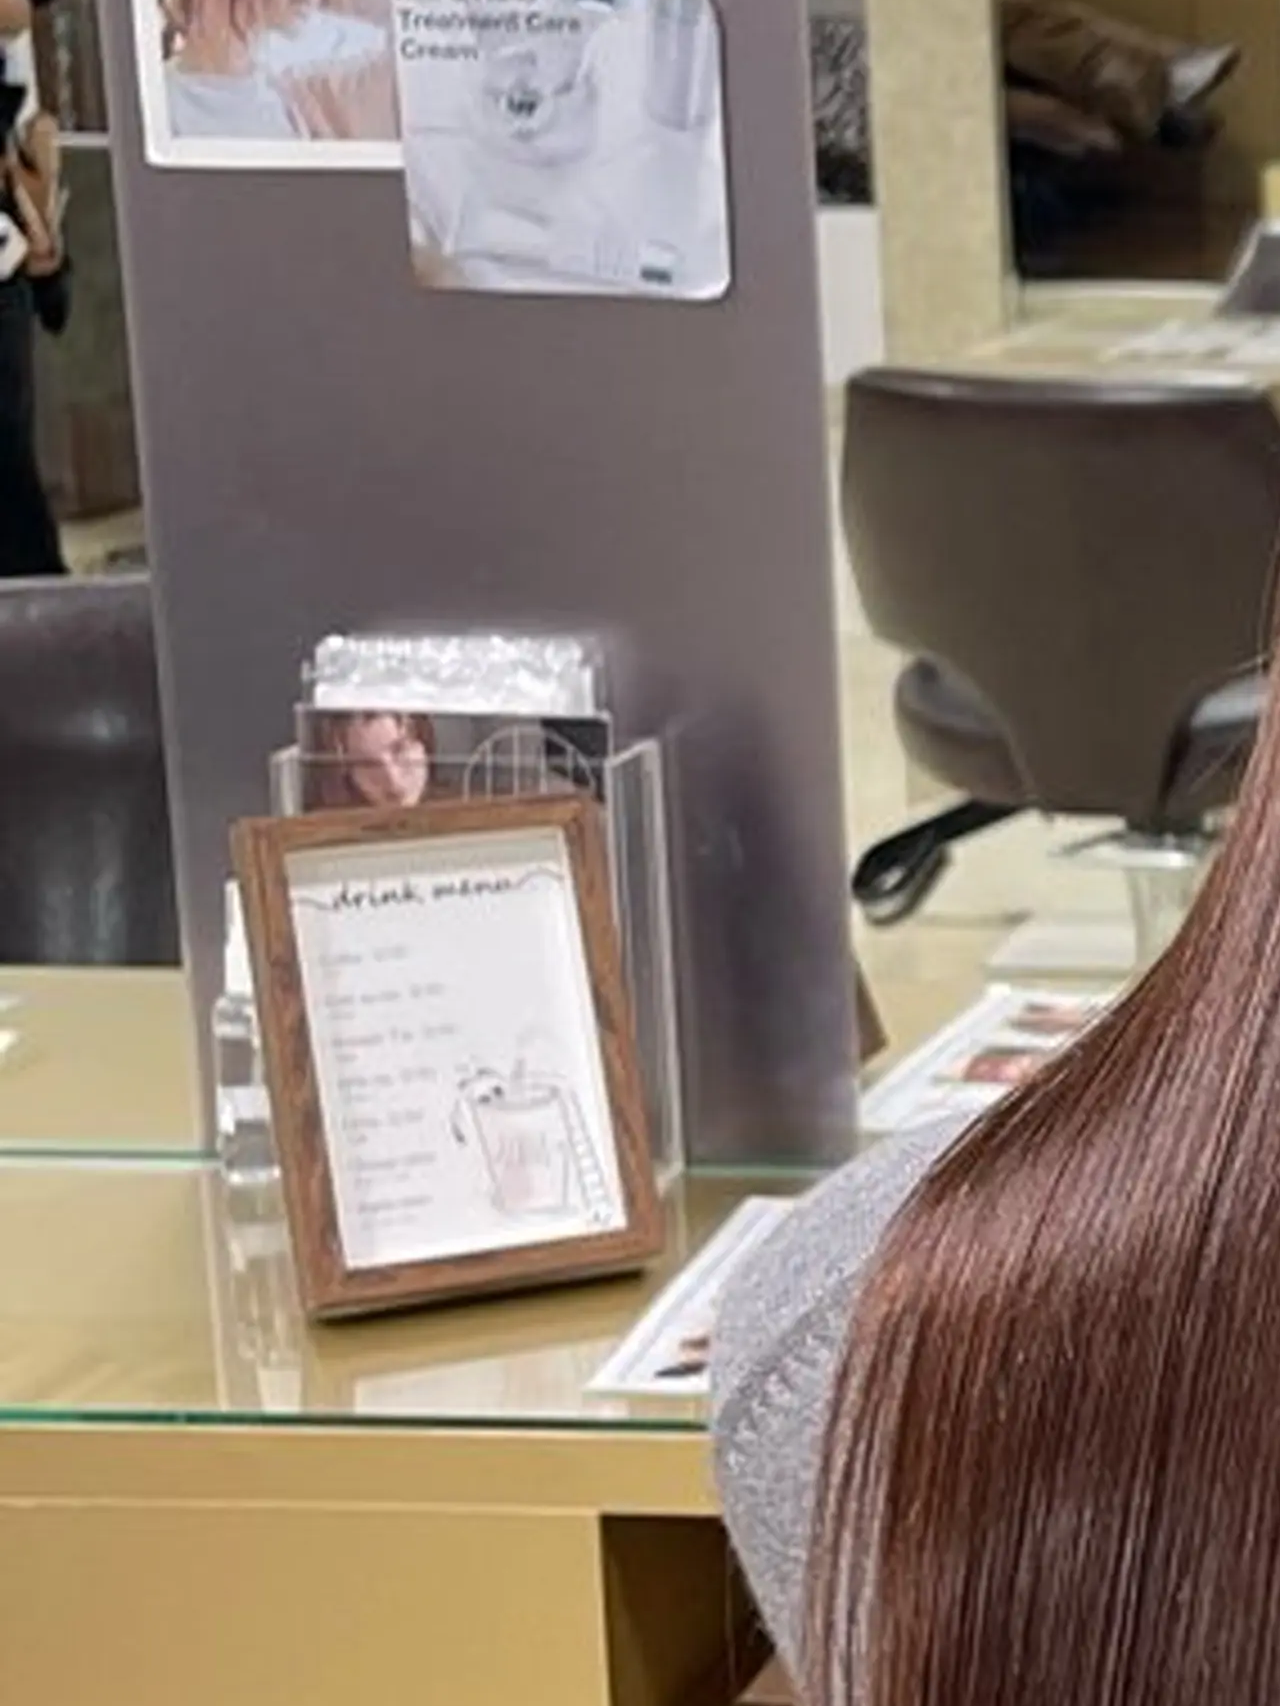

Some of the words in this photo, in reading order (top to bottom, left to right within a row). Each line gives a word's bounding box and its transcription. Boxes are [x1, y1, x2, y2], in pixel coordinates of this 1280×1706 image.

[401, 9, 520, 32] Treatment
[526, 11, 582, 33] Care
[400, 37, 479, 61] Cream
[332, 878, 424, 911] drink
[431, 877, 512, 899] menu
